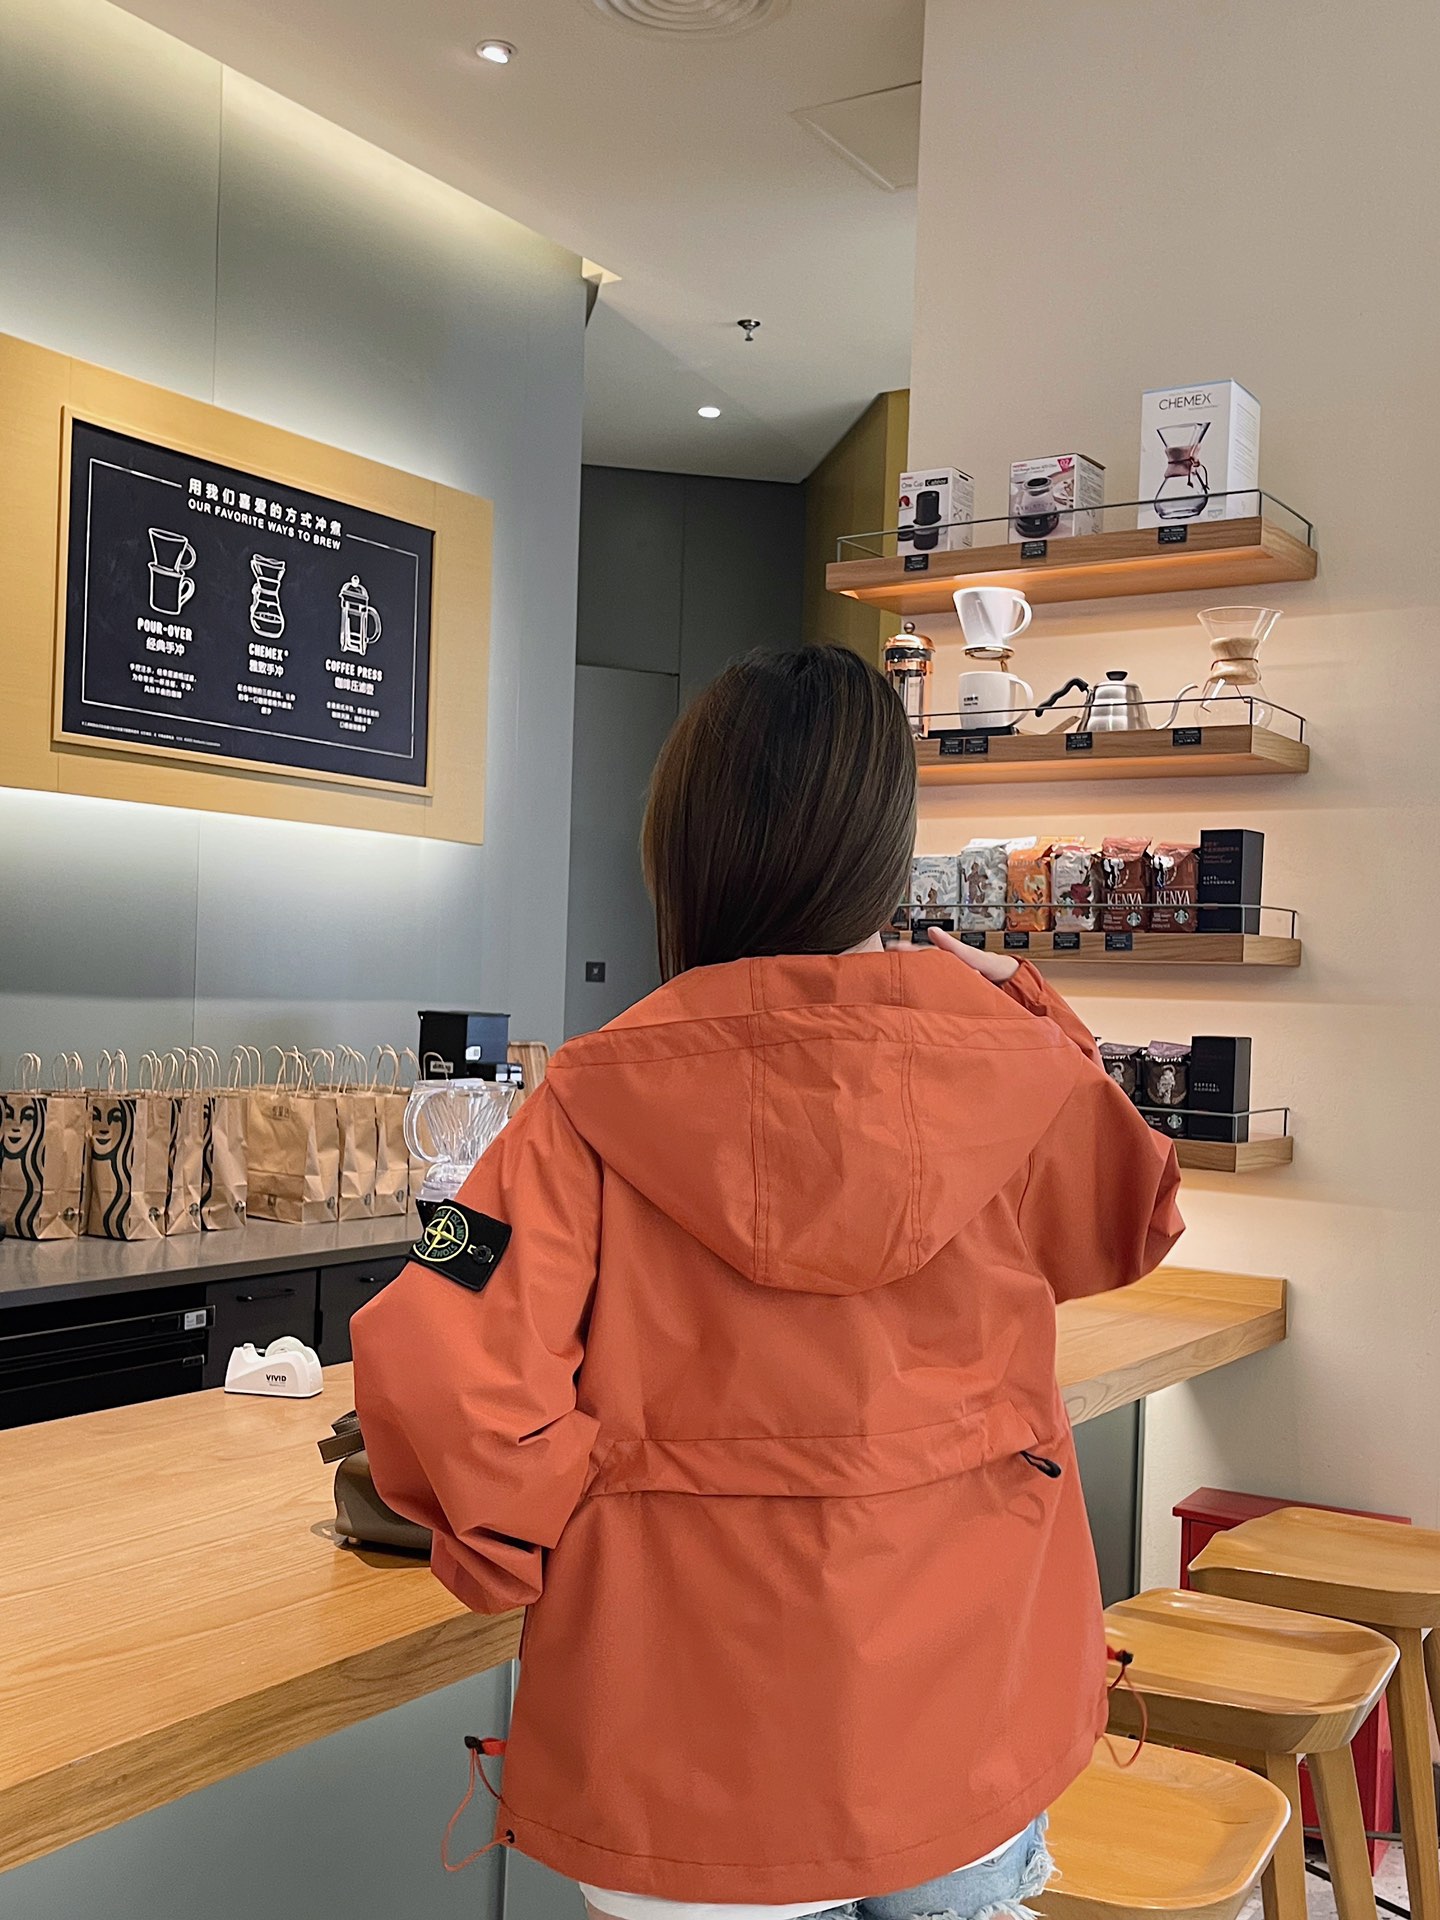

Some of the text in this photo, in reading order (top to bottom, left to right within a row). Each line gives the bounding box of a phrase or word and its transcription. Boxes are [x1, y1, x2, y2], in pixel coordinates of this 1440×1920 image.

[1158, 393, 1212, 410] CHEMEX
[188, 477, 342, 537] 用我们喜爱的方式冲煮
[188, 498, 341, 551] OUR FAVORITE WAYS TO BREW
[146, 636, 185, 656] 经典手冲
[325, 658, 383, 682] COFFEE PRESS
[1106, 892, 1143, 905] KENYA
[1156, 890, 1191, 905] KENYA
[265, 1373, 287, 1382] VIVID
